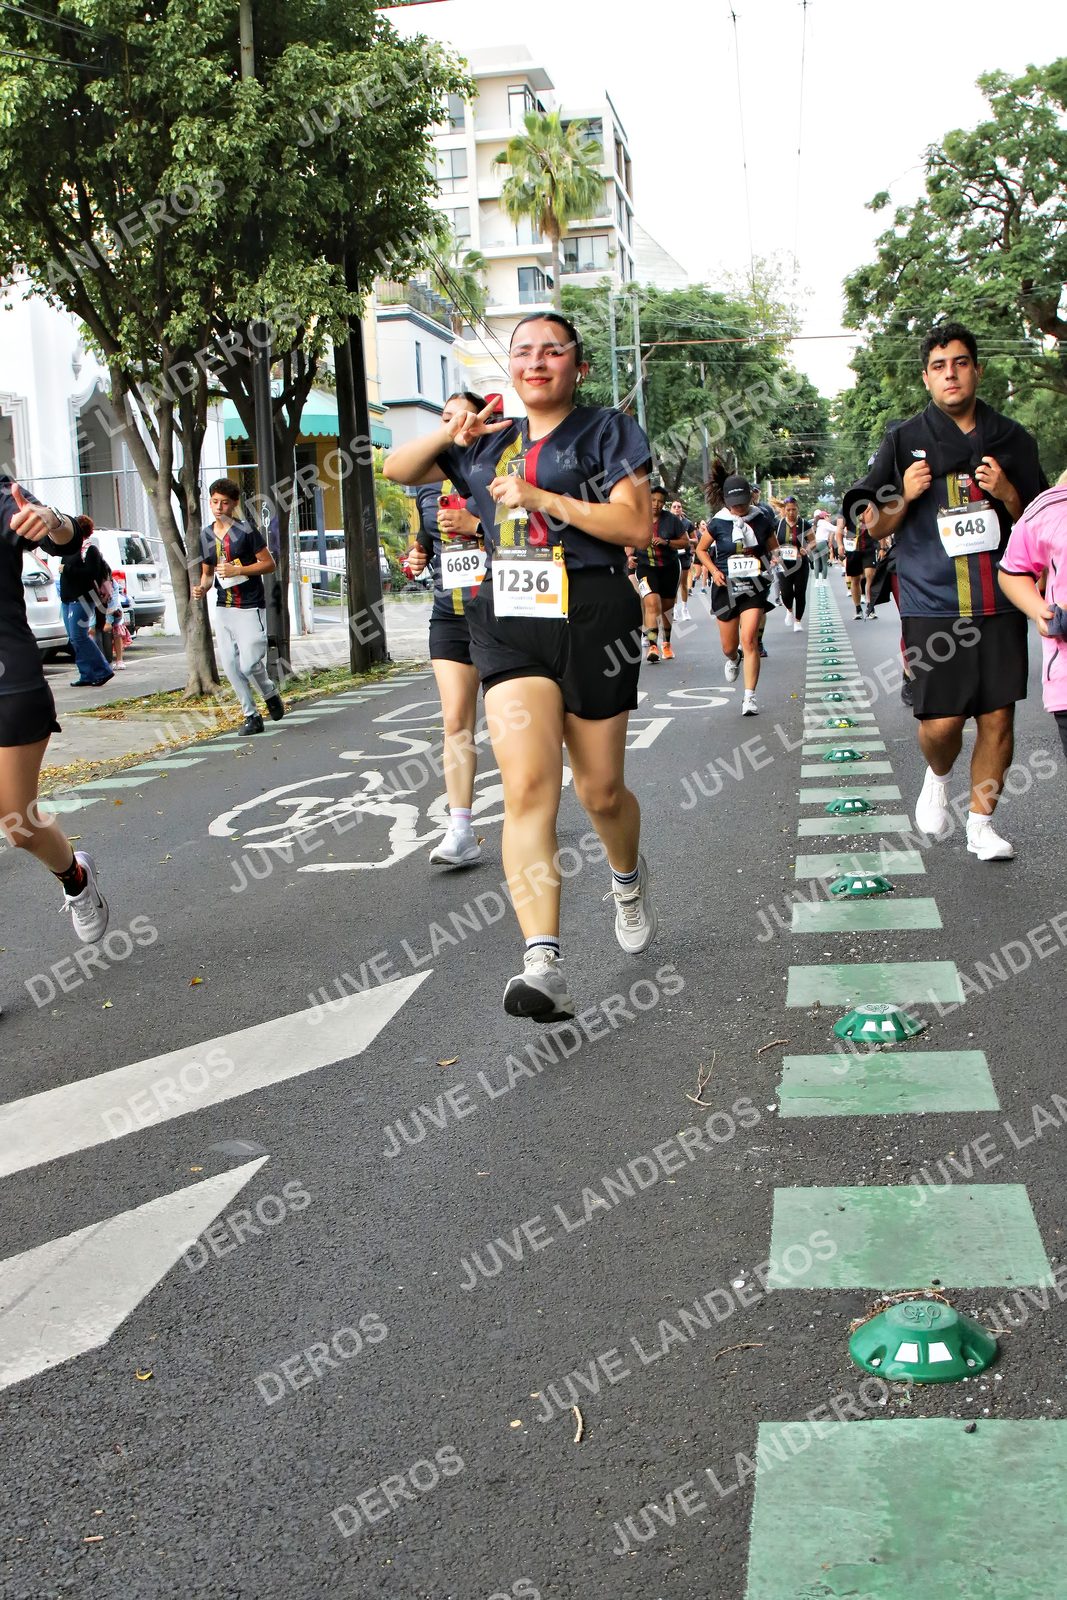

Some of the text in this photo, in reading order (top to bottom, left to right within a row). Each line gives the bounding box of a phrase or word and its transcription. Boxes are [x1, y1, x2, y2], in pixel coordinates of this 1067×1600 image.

[954, 517, 986, 537] 648
[447, 555, 480, 573] 6689
[732, 560, 754, 570] 3177
[498, 569, 550, 593] 1236
